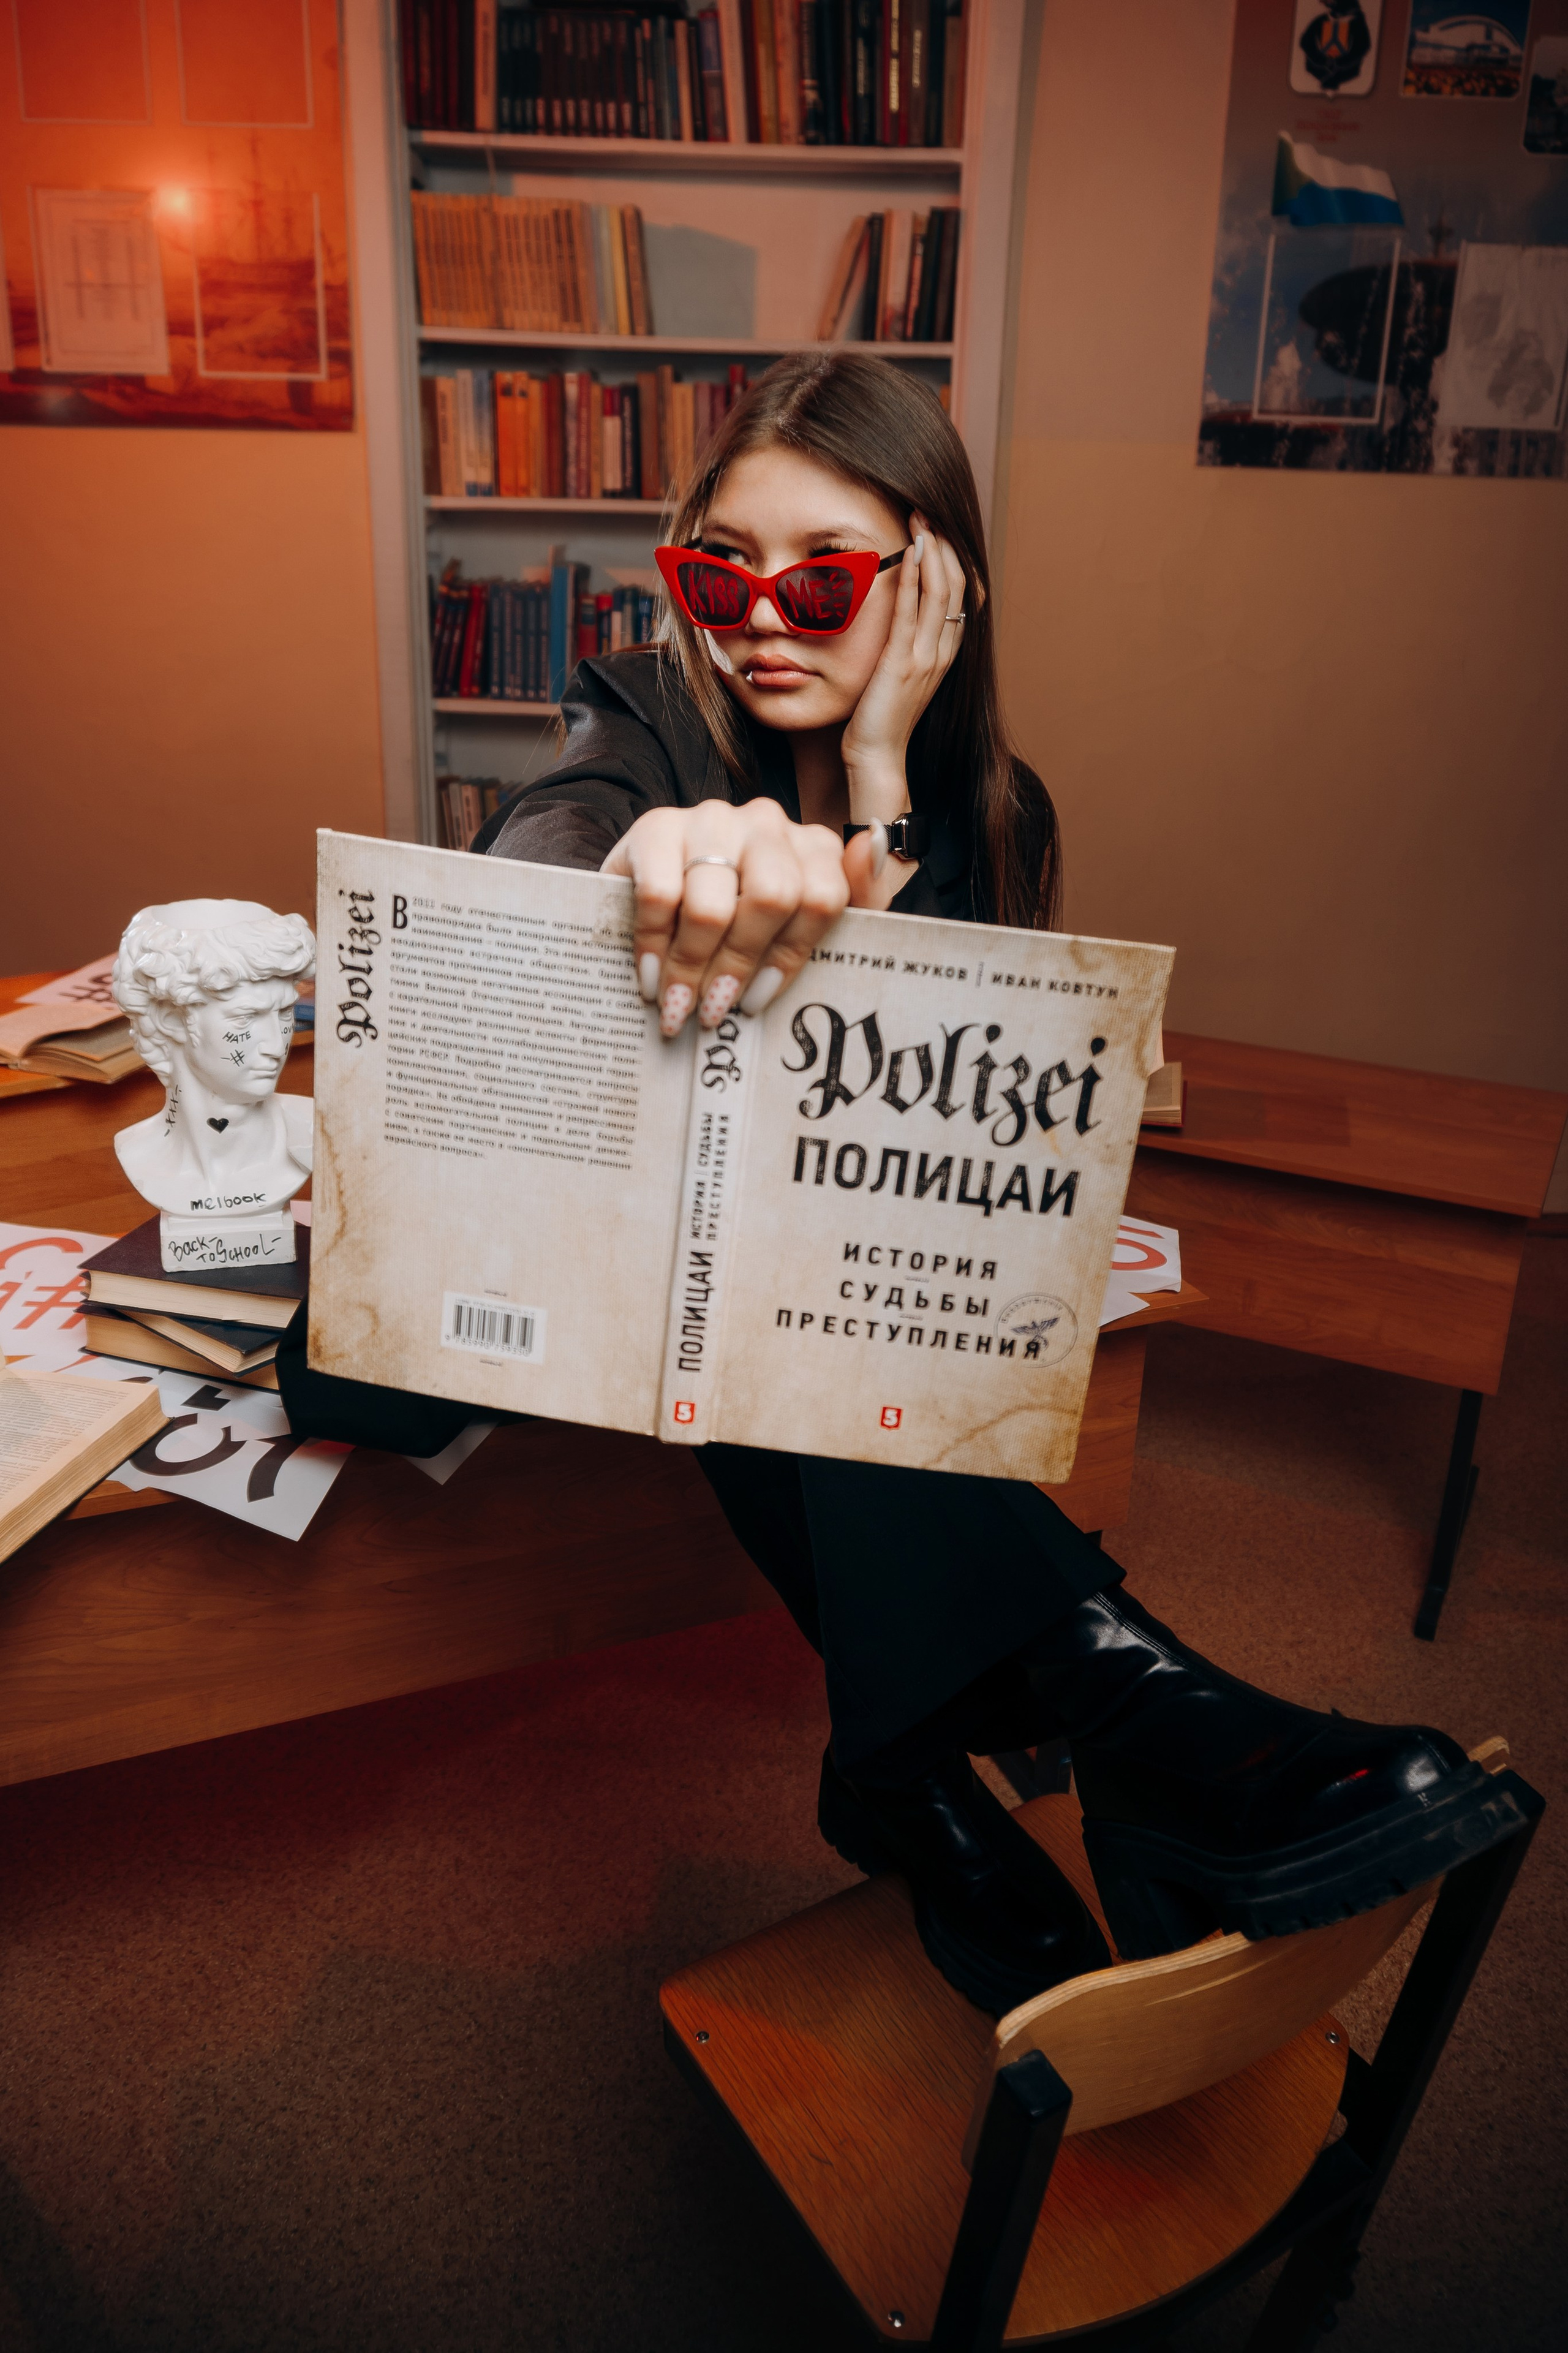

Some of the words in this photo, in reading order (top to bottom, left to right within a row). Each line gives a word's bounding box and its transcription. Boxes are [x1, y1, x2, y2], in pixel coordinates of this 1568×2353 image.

[688, 570, 739, 618] KISS
[786, 576, 832, 619] ME
[336, 889, 382, 1048] Polizei
[902, 960, 969, 982] ЖУКОВ
[992, 972, 1042, 989] ИВАН
[1048, 978, 1120, 999] КОВТУН
[222, 1030, 252, 1044] HATE
[780, 1002, 1107, 1146] Polizei
[792, 1136, 1082, 1217] ПОЛИЦАИ
[843, 1242, 998, 1280] ИСТОРИЯ
[678, 1250, 714, 1373] ПОЛИЦАИ
[839, 1279, 990, 1316] СУДЬБЫ
[777, 1309, 1042, 1359] ПРЕСТУПЛЕНИЯ
